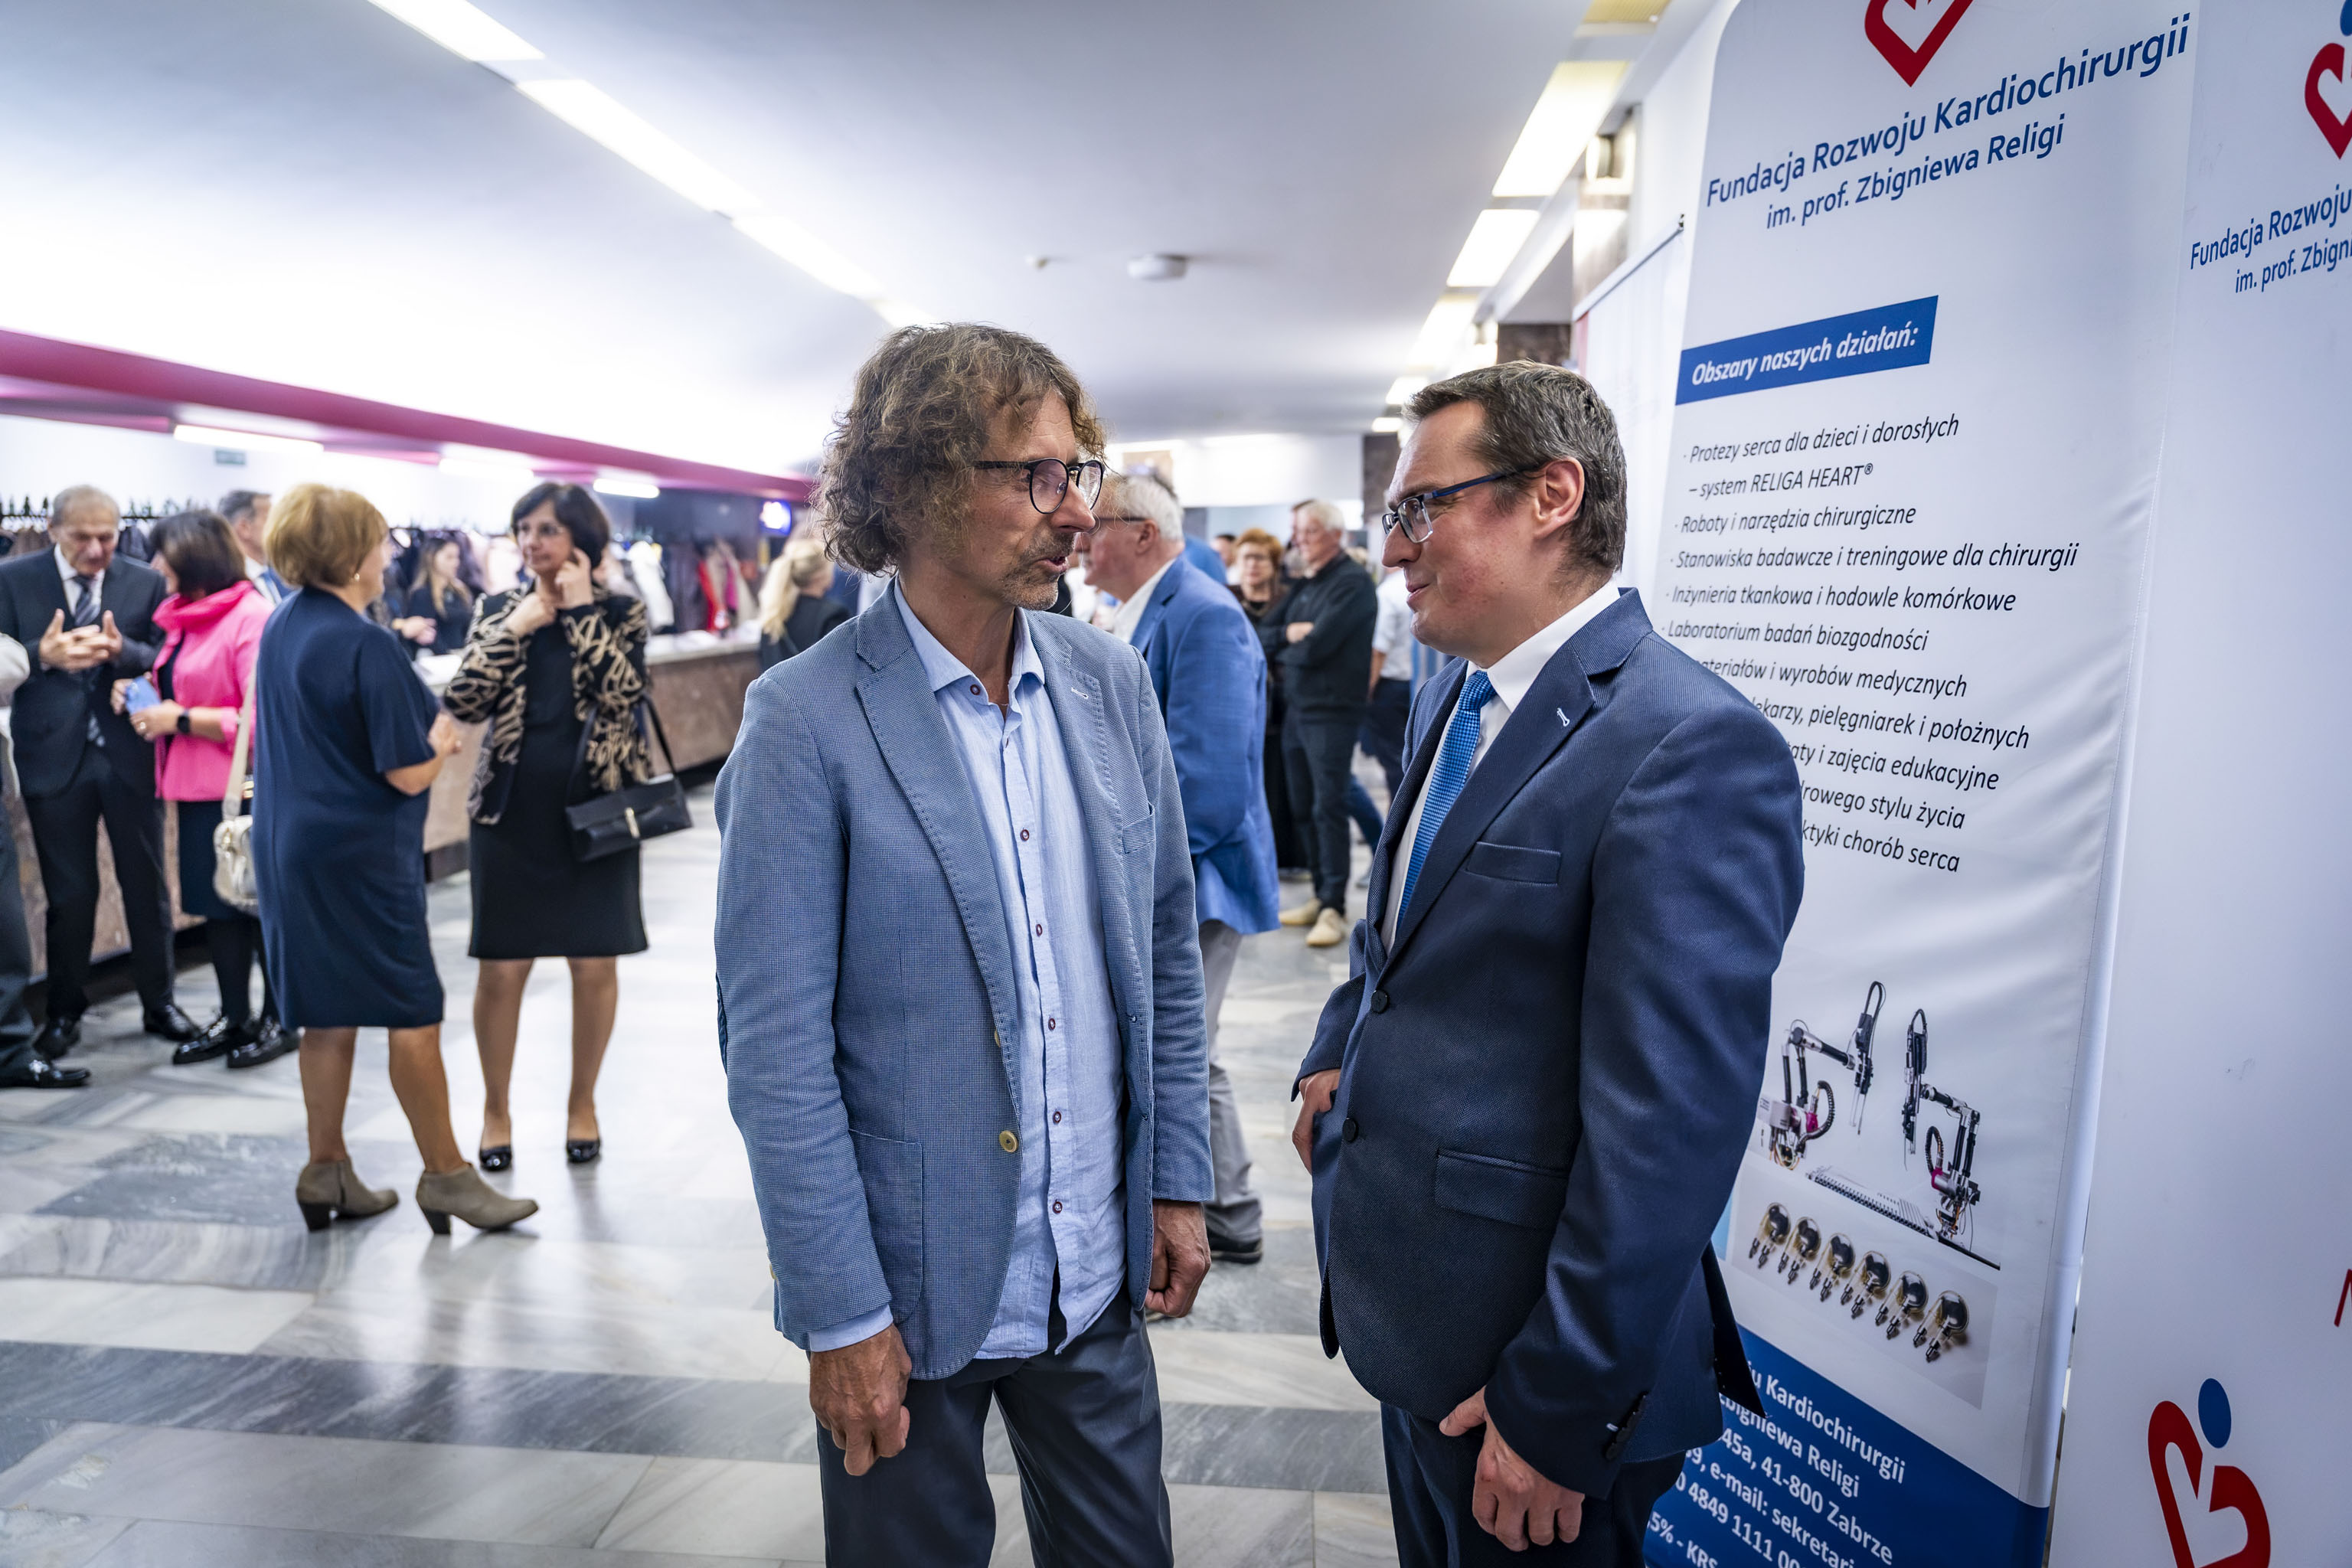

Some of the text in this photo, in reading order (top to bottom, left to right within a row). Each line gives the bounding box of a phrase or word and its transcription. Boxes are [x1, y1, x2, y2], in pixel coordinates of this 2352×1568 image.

[1707, 11, 2190, 207] Fundacja Rozwoju Kardiochirurgii
[1767, 113, 2066, 229] im. prof. Zbigniewa Religi
[2190, 183, 2352, 270] Fundacja Rozwoju
[2235, 269, 2258, 293] im.
[2261, 249, 2297, 292] prof.
[1691, 320, 1919, 386] Obszary naszych działań:
[1689, 412, 1960, 463] Protezy serca dla dzieci i dorosłych
[1700, 476, 1747, 501] system
[1750, 470, 1803, 493] RELIGA
[1681, 504, 1917, 536] Roboty i narzędzia chirurgiczne
[1675, 542, 2081, 572] Stanowiska badawcze i treningowe dla chirurgii
[1671, 583, 2017, 612] Inżynieria tkankowa i hodowle komórkowe
[1668, 619, 1930, 652] Laboratorium badań biozgodności
[1769, 662, 1777, 680] i
[1779, 663, 1854, 688] wyrobów
[1855, 668, 1968, 700] medycznych
[1808, 704, 1916, 735] pielęgniarek
[1919, 715, 1927, 736] i
[1928, 717, 2030, 751] położnych
[1787, 741, 2000, 792] aty i zajęcia edukacyjne
[1869, 796, 1913, 821] stylu
[1916, 801, 1966, 829] życia
[1843, 829, 1904, 860] chorób
[1908, 846, 1961, 873] serca
[1766, 1374, 1906, 1485] Kardiochirurgii
[1710, 1462, 1769, 1516] e-mail:
[1807, 1444, 1860, 1498] Religi
[1717, 1428, 1893, 1566] 45a, 41-800 Zabrze
[1647, 1511, 1674, 1544] 5%
[1687, 1481, 1730, 1524] 4849
[1732, 1514, 1774, 1563] 1111
